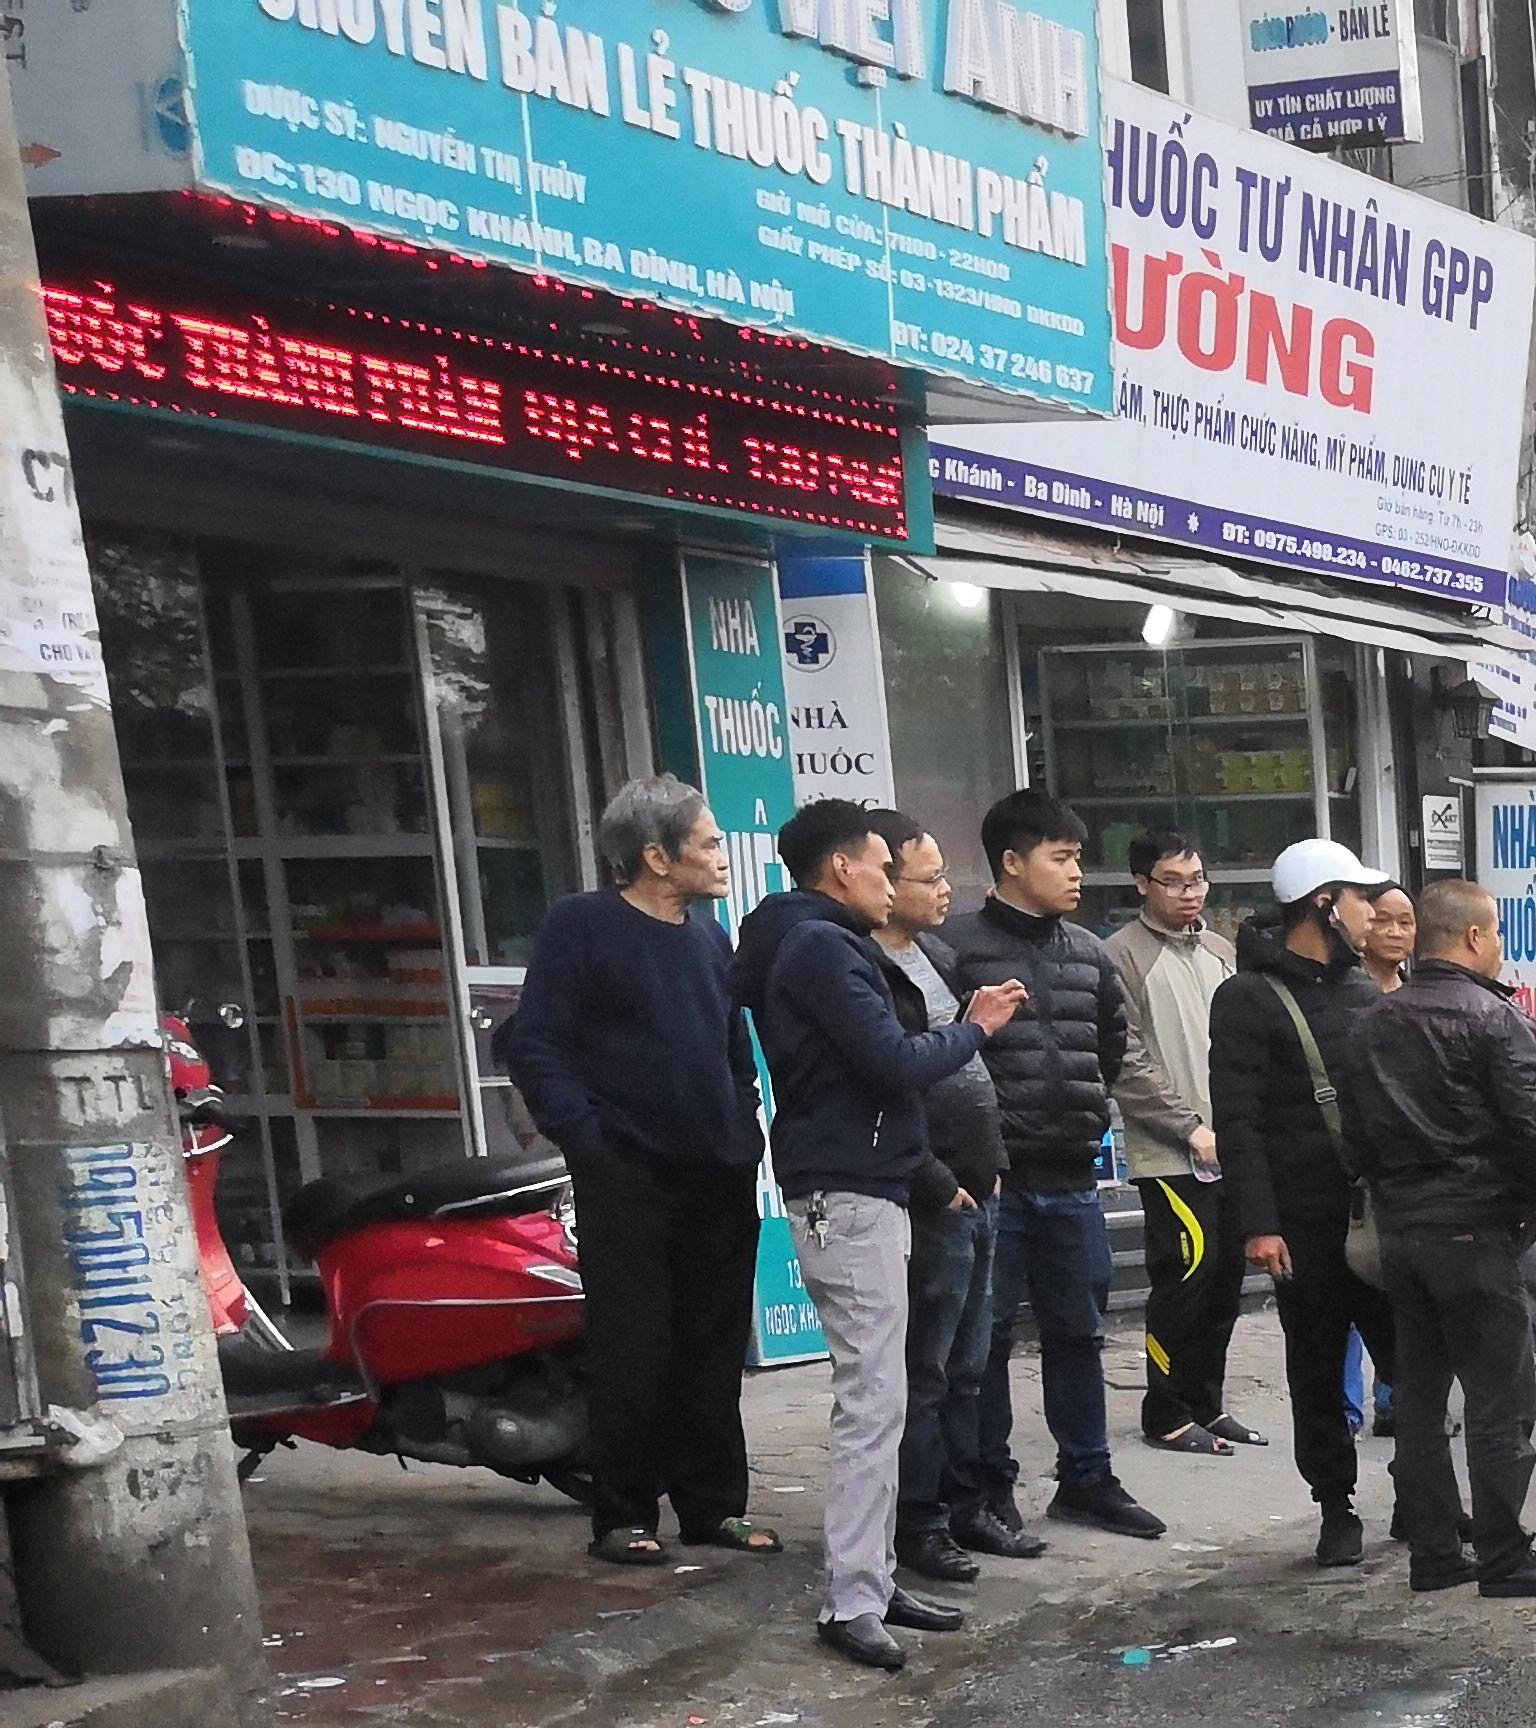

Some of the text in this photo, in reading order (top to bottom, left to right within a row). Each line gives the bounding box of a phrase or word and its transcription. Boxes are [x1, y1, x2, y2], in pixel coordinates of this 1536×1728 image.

[1254, 98, 1274, 118] UY
[1277, 91, 1302, 116] TÍN
[1304, 85, 1344, 113] CHẤT
[374, 115, 477, 175] NGUYỄN
[480, 146, 523, 196] THỊ
[617, 29, 682, 139] LẺ
[682, 70, 832, 185] THUỐC
[835, 121, 976, 232] THÀNH
[977, 154, 1087, 266] PHẨM
[366, 179, 460, 234] NGỌC
[584, 235, 626, 274] BA
[706, 261, 747, 308] HÀ
[1234, 166, 1292, 263] TƯ
[1299, 199, 1412, 306] NHÂN
[1423, 238, 1496, 332] GPP
[930, 332, 975, 366] 024
[979, 342, 1008, 373] 37
[1009, 352, 1052, 386] 246
[1055, 362, 1095, 396] 637
[1153, 389, 1190, 440] THỰC
[1194, 393, 1236, 447] PHẨM
[1240, 411, 1277, 457] CHỨC
[1392, 454, 1426, 496] DỤNG
[1449, 468, 1456, 501] Y
[944, 457, 1002, 492] Khánh
[1024, 474, 1049, 502] Ba
[1110, 493, 1134, 520] Hà
[1136, 499, 1166, 530] Nội
[704, 681, 782, 760] THUỐC
